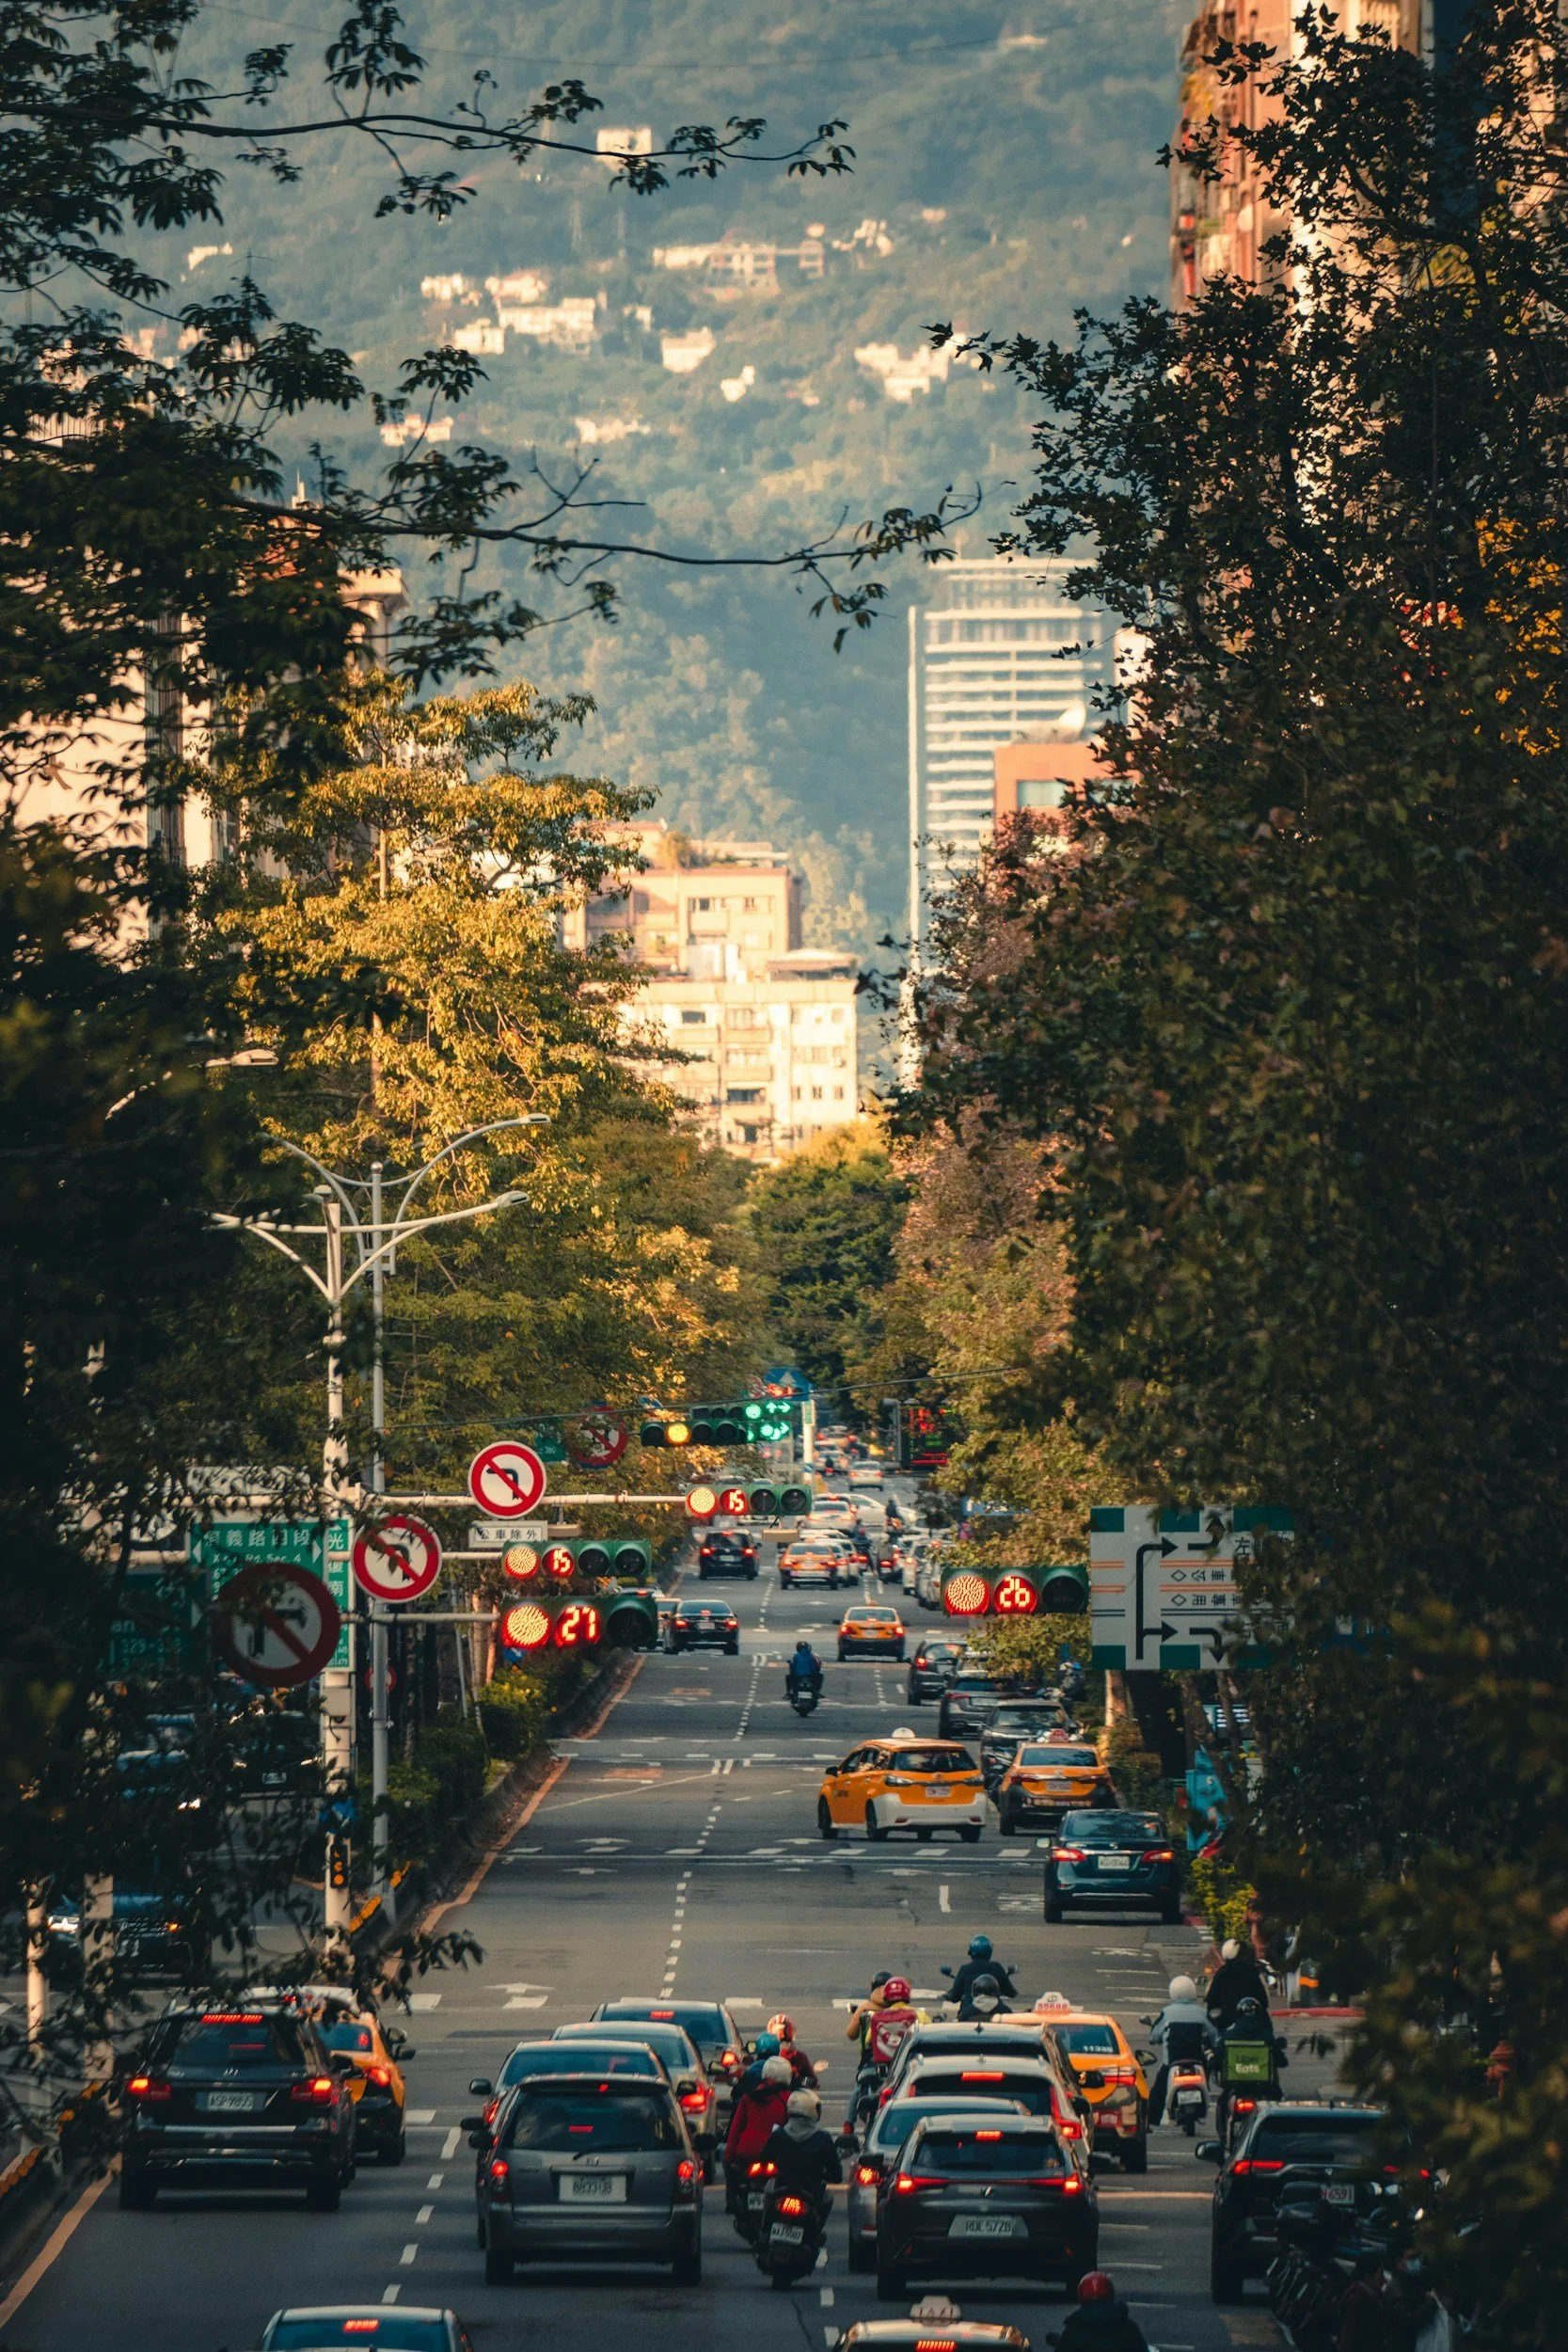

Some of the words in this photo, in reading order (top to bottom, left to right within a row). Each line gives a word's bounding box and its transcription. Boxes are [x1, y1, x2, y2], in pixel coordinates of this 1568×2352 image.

[729, 1489, 744, 1512] 15
[479, 1530, 537, 1540] 公車除外
[293, 1553, 302, 1564] 4
[553, 1547, 570, 1572] 15
[999, 1575, 1031, 1608] 26
[562, 1606, 596, 1641] 27
[1235, 2063, 1260, 2074] Eats
